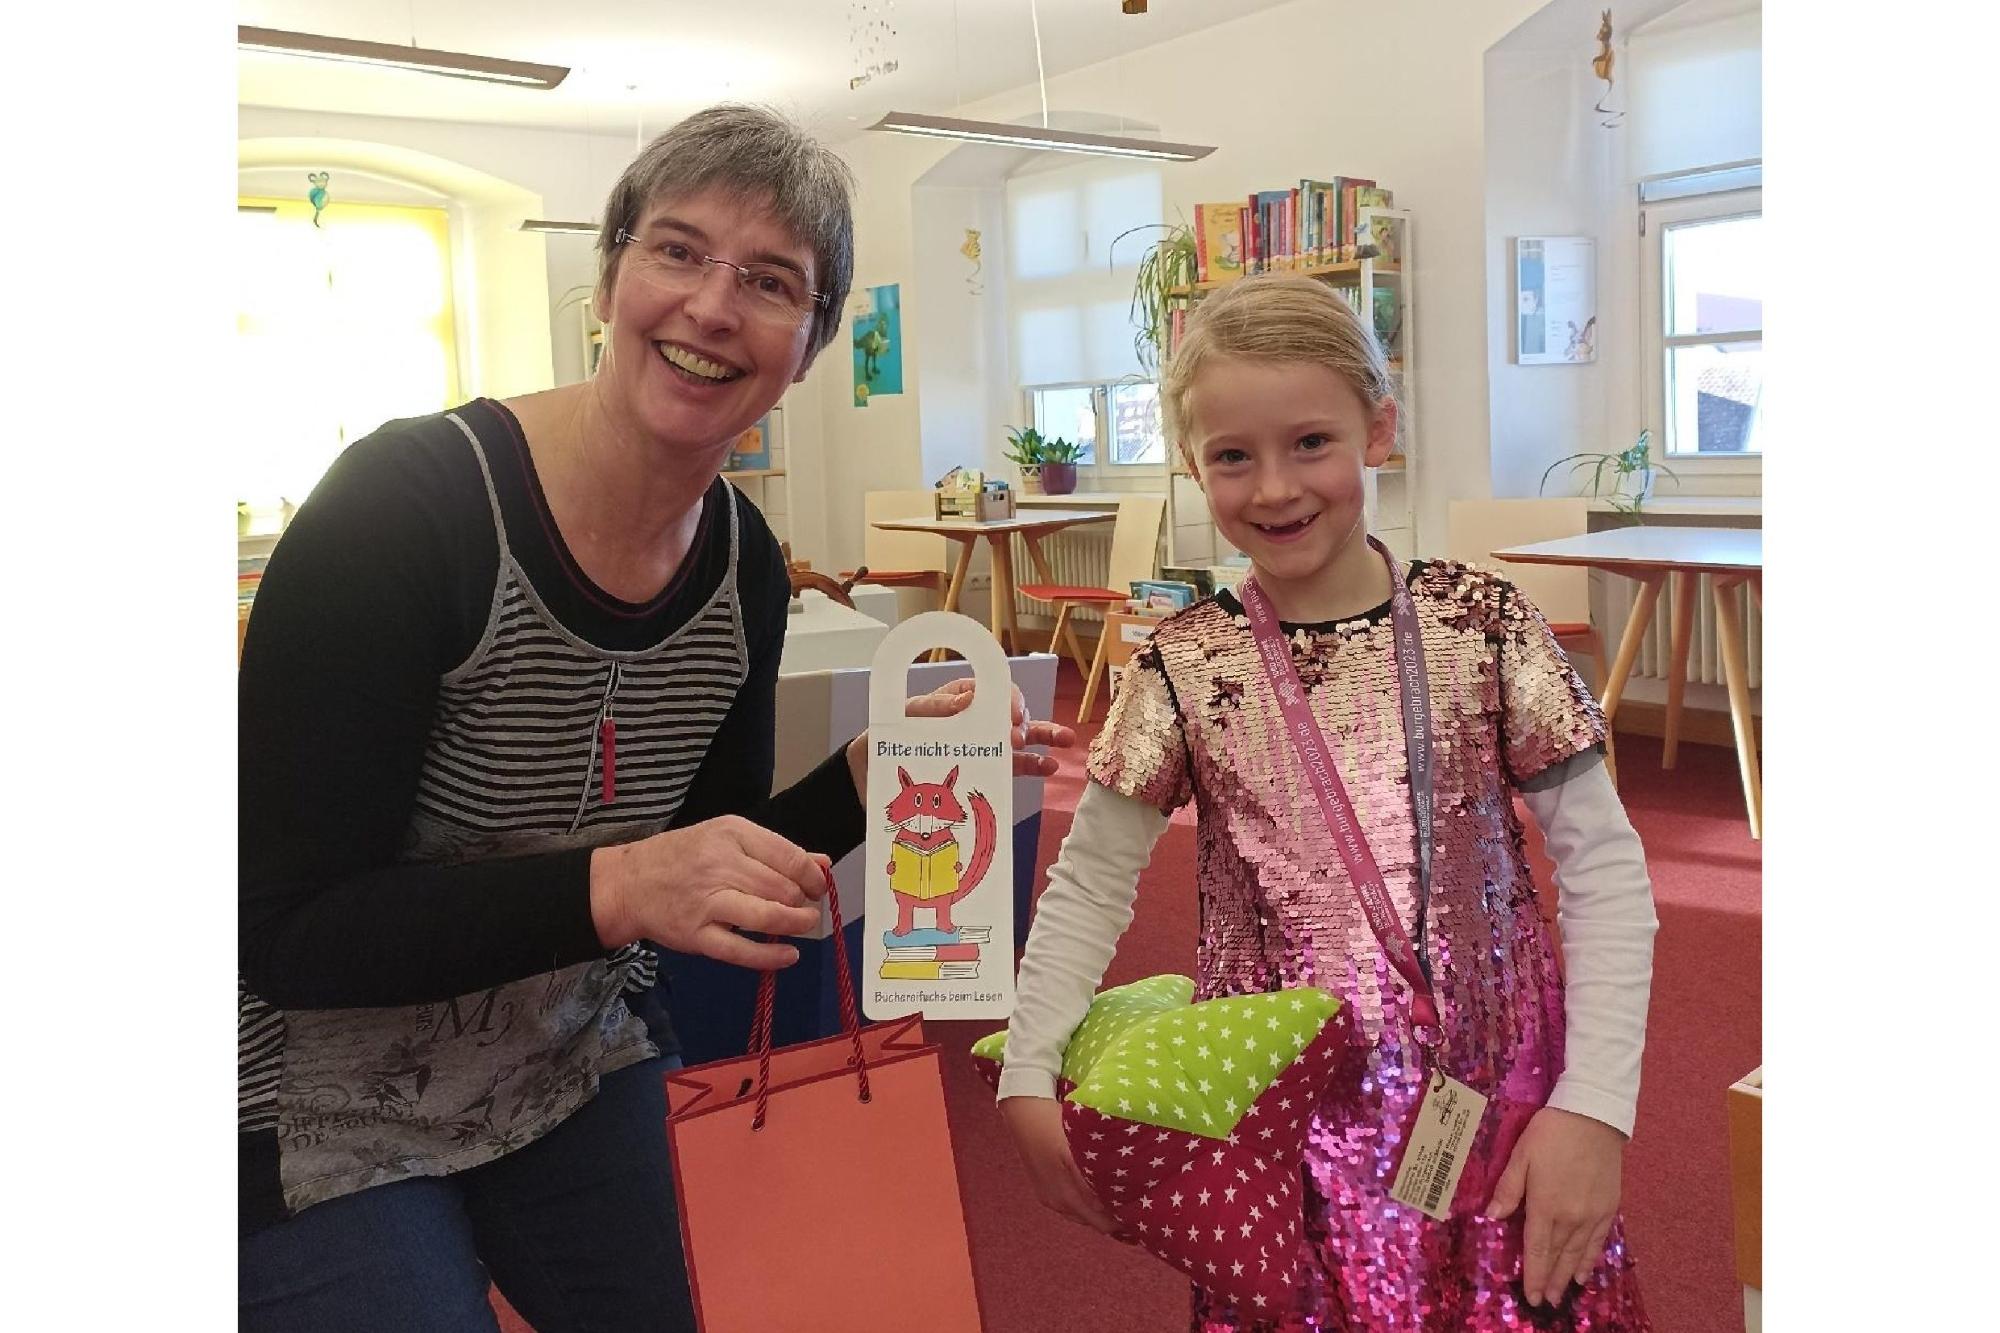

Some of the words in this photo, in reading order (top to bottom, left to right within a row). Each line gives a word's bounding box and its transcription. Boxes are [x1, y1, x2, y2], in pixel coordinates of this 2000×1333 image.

[877, 740, 912, 757] Bitte
[915, 741, 950, 757] nicht
[953, 741, 1003, 757] stören!
[949, 990, 972, 1002] beim
[974, 990, 1003, 1001] Lesen
